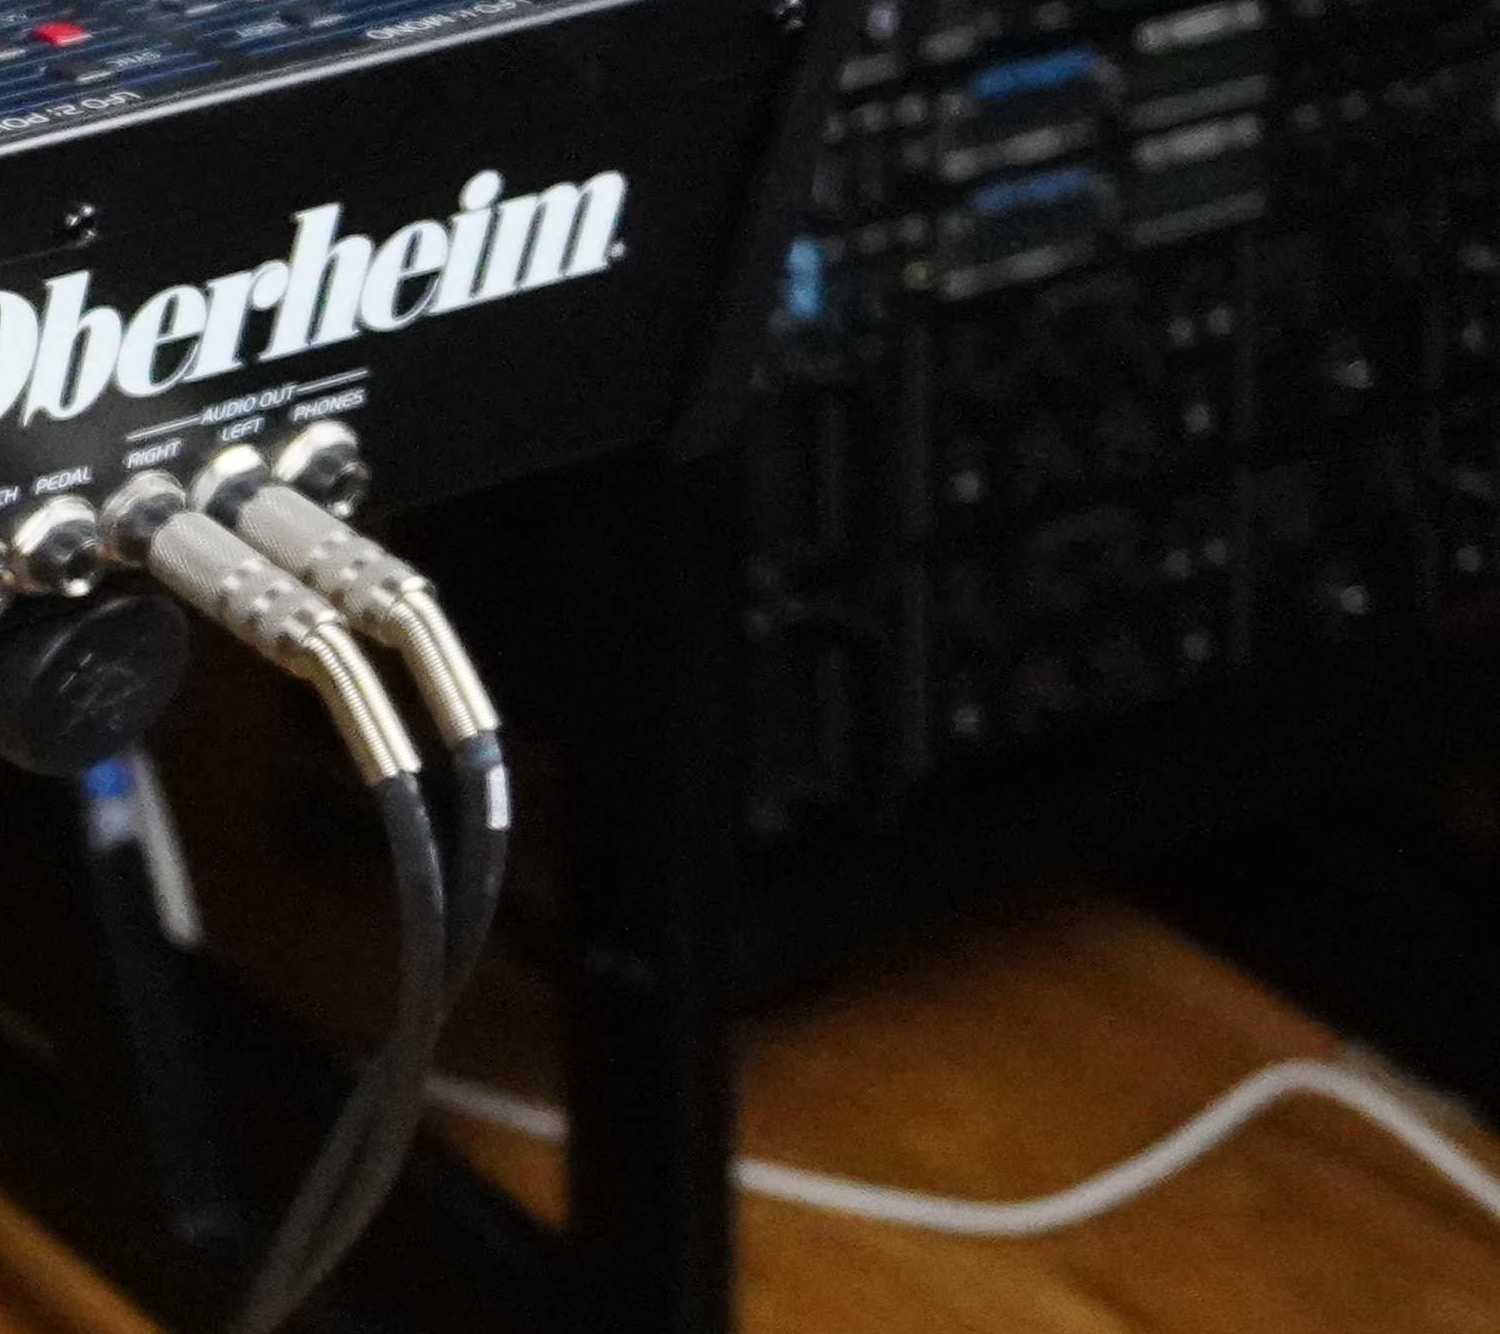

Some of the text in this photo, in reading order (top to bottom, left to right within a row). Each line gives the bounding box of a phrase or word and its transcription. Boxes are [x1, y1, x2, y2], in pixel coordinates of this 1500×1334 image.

[79, 89, 141, 109] LFO
[200, 384, 298, 425] AUDIO OUT
[292, 388, 366, 422] PHONES
[220, 417, 266, 443] LEFT
[125, 439, 183, 468] RIGHT
[33, 468, 93, 496] PEDAL
